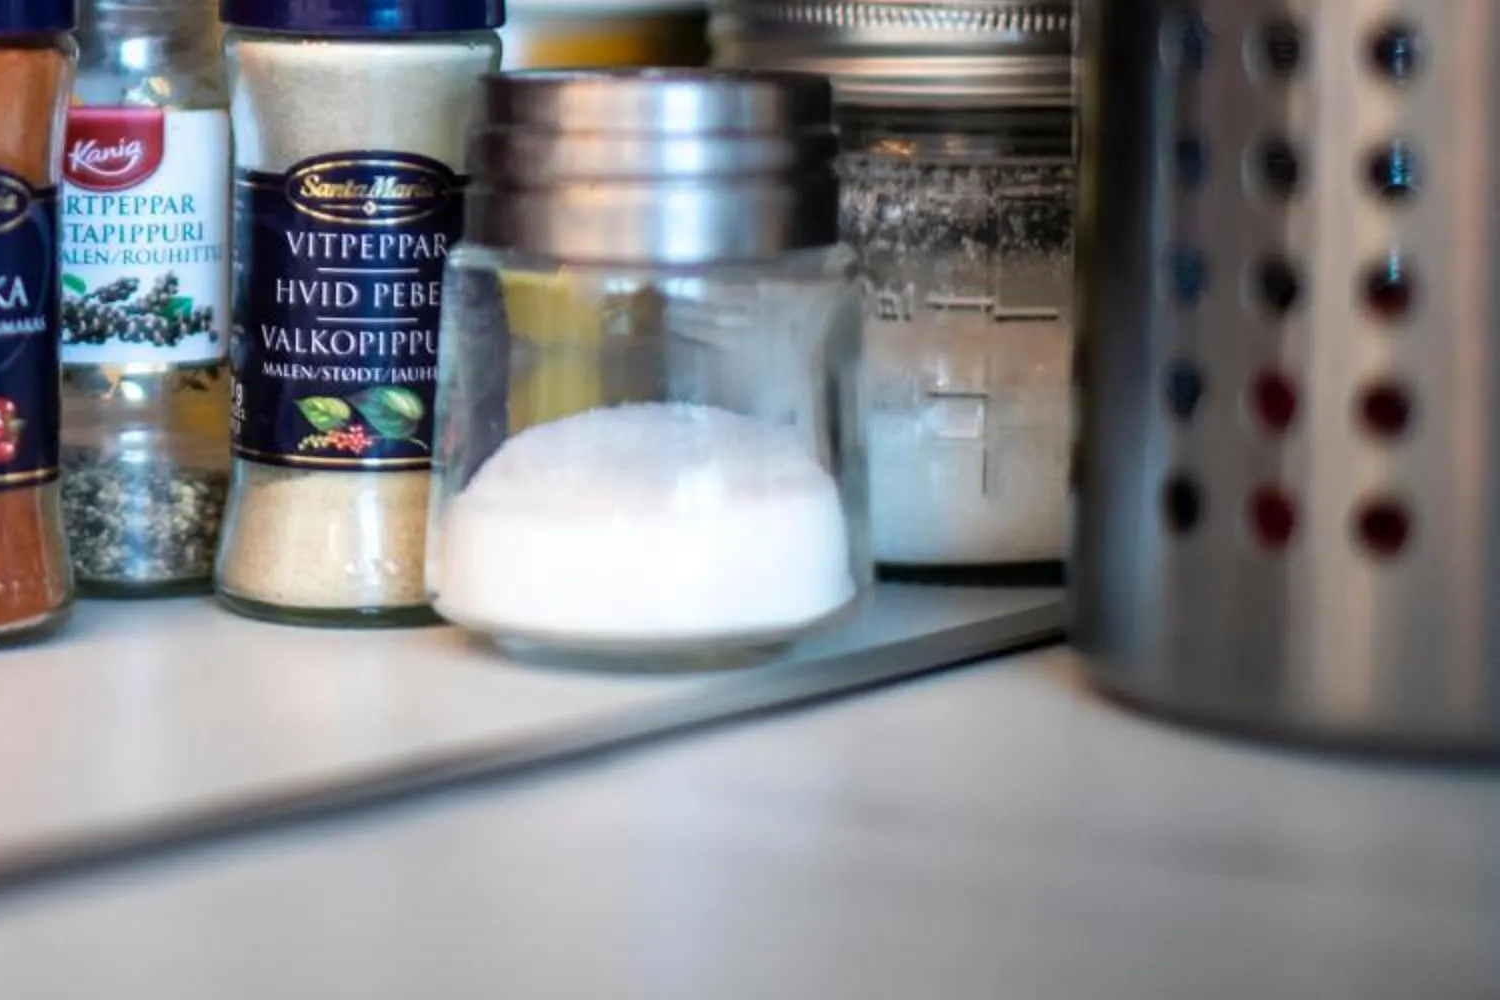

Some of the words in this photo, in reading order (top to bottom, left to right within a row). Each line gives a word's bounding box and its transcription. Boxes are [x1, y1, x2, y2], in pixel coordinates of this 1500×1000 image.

[60, 194, 196, 216] RTPEPPAR
[286, 231, 448, 259] VITPEPPAR
[276, 278, 358, 308] HVID
